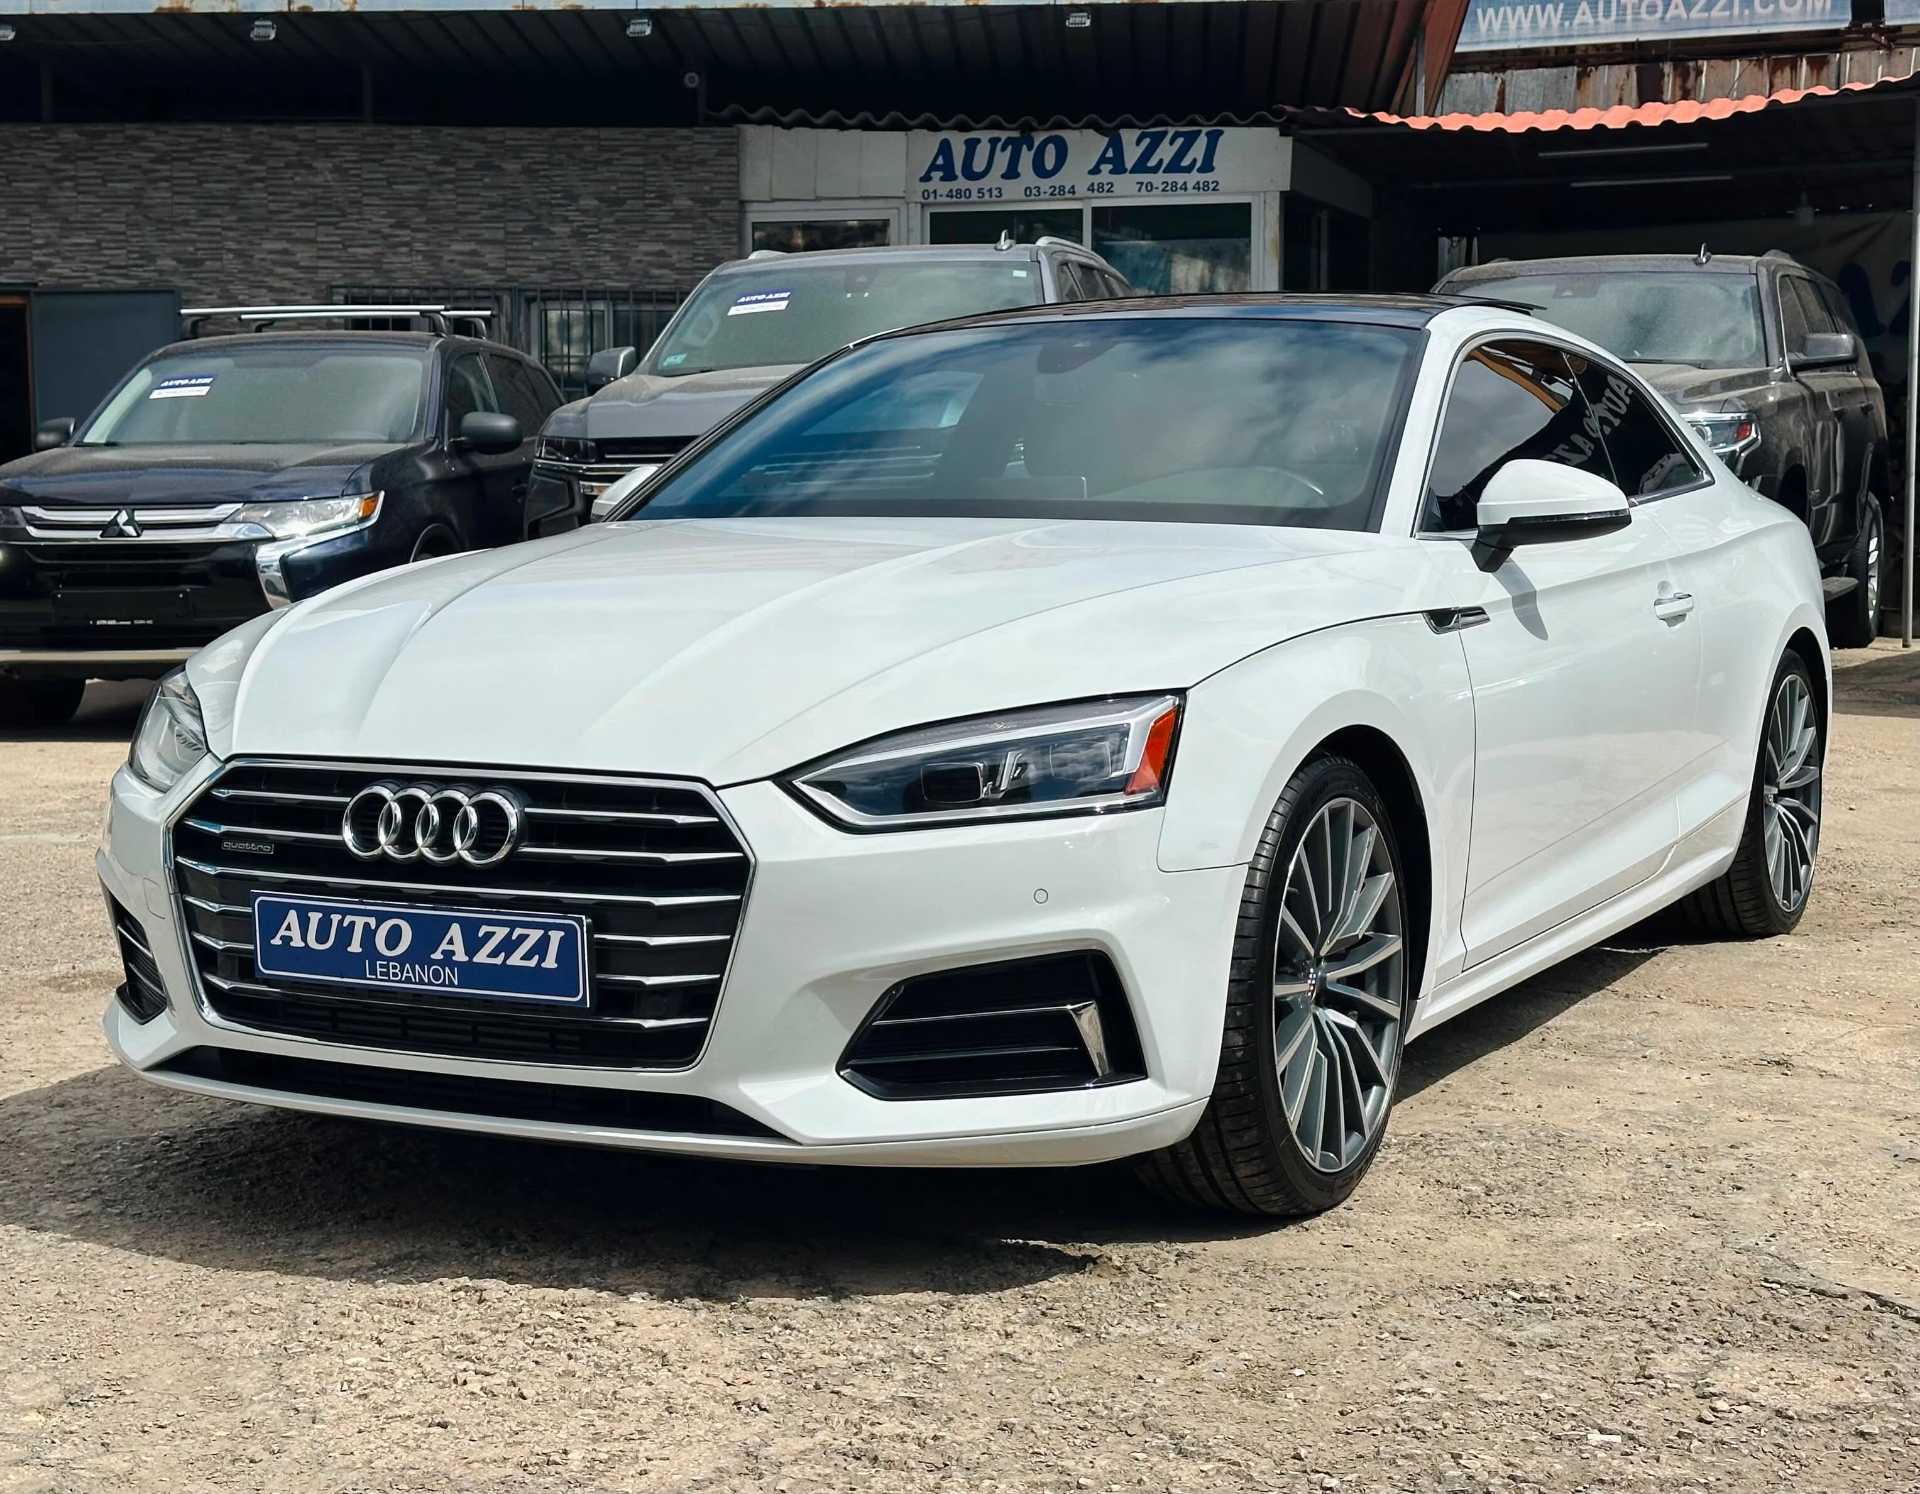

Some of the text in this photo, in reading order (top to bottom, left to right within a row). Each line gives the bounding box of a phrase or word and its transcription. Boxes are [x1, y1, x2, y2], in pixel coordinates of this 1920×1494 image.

[919, 129, 1224, 183] AUTO AZZI
[921, 180, 1220, 200] 01-480 513 03-284 482 70-284 482
[223, 841, 272, 852] quattro
[270, 909, 565, 969] AUTO AZZI
[365, 959, 459, 987] LEBANON
